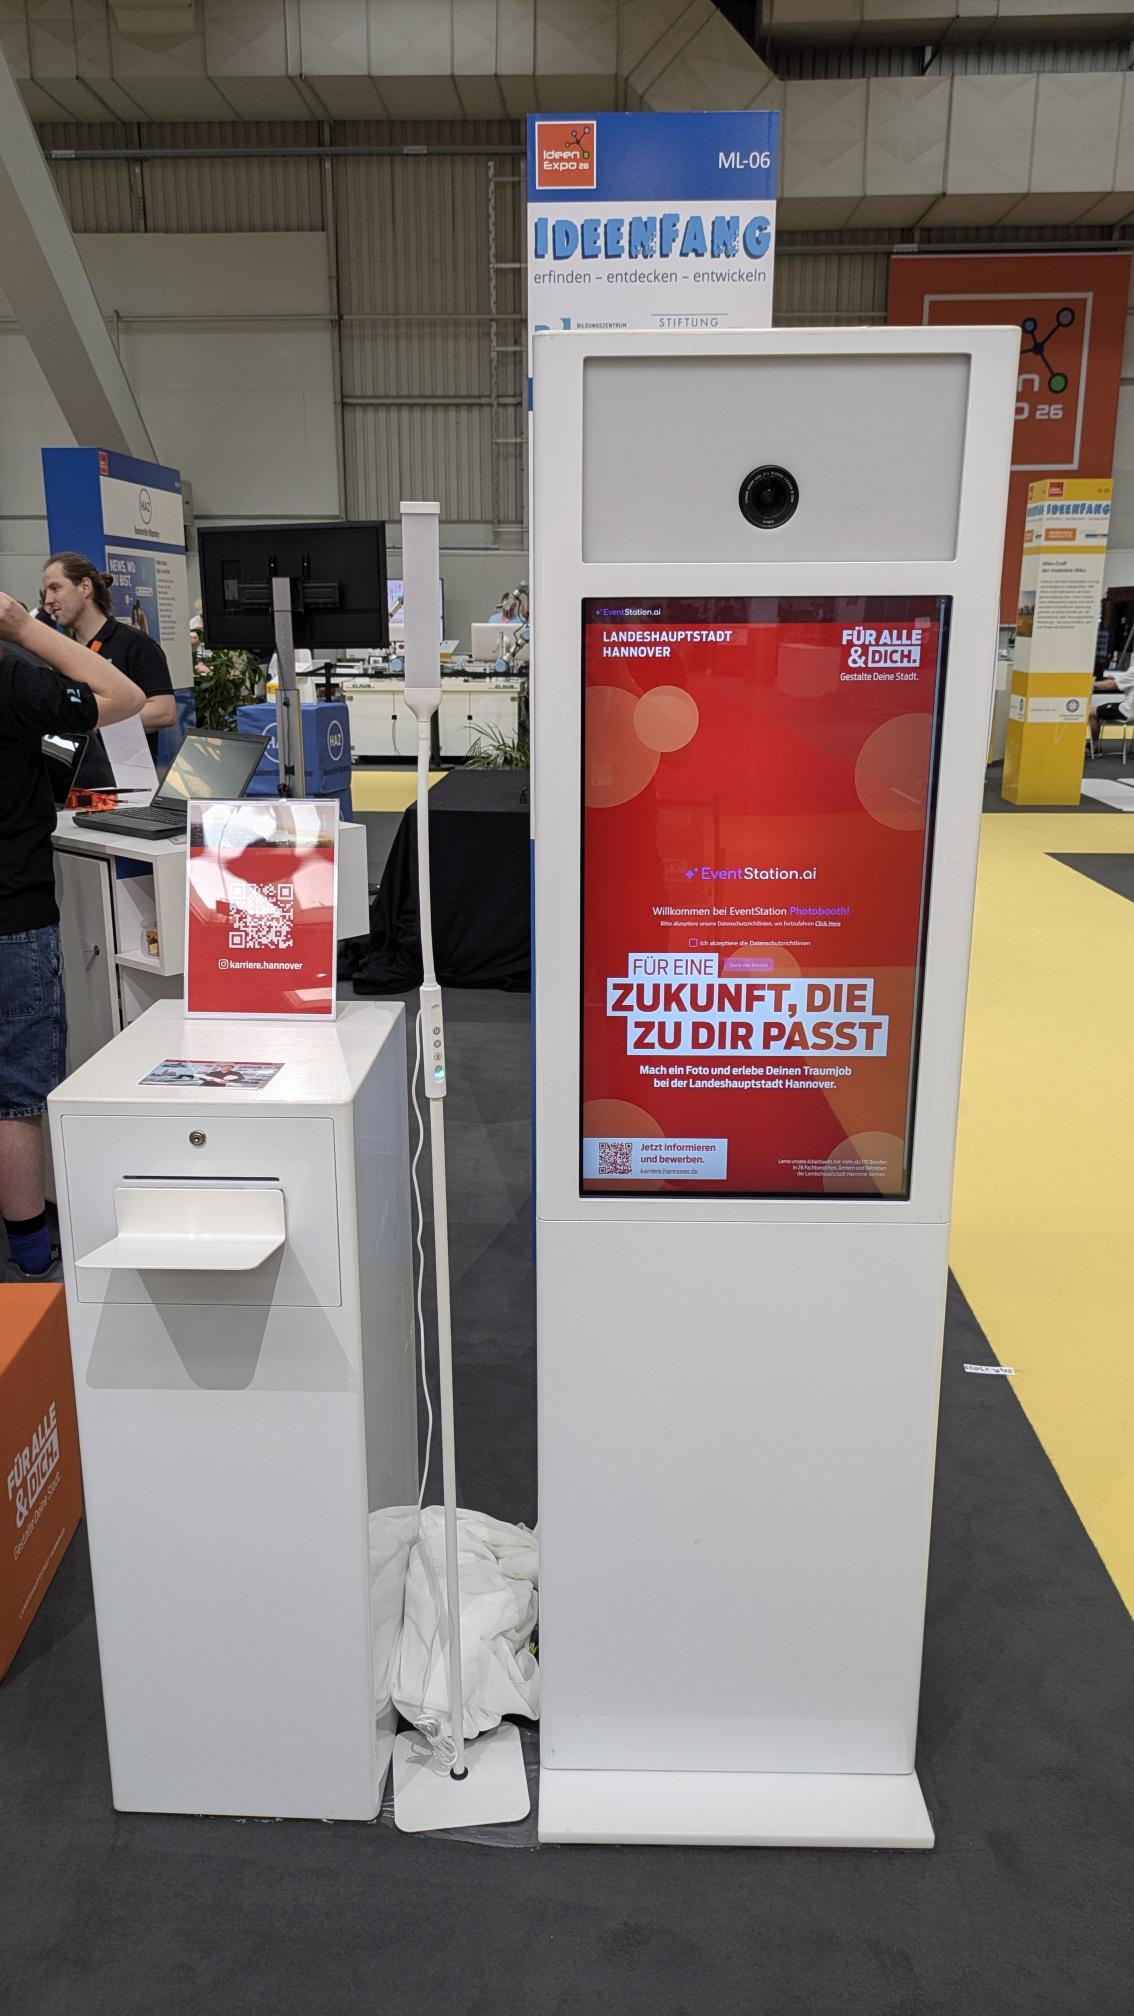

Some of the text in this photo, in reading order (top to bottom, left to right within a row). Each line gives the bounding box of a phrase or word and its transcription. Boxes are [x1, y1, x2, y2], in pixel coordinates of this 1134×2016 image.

[543, 150, 580, 160] Ideen
[718, 151, 771, 169] ML-06
[543, 160, 577, 172] Expo
[534, 213, 772, 261] IDEENFANG
[533, 270, 592, 284] erfinden
[606, 269, 678, 284] entdecken
[693, 269, 766, 283] entwickeln
[659, 317, 719, 328] STIFTUNG
[1035, 403, 1064, 420] 26
[603, 608, 661, 617] EventStation.ai
[603, 631, 732, 643] LANDESHAUPTSTADT
[842, 626, 922, 645] FÜR ALLE
[603, 646, 671, 658] HANNOVER
[847, 647, 917, 667] & DICH.
[840, 672, 919, 681] Gestalte Deine Stadt.
[329, 735, 342, 747] HAZ
[701, 866, 816, 880] EventStation.ai
[652, 906, 850, 916] Willkommen bei EventStation Photobooth!
[672, 920, 699, 928] akzeptiere
[815, 920, 828, 928] Click
[828, 920, 842, 928] Here
[709, 940, 738, 948] akzeptiere
[229, 959, 304, 971] karriere.hannover
[632, 955, 714, 976] FÜR EINE
[611, 983, 868, 1018] ZUKUNFT, DIE
[632, 1021, 883, 1051] ZU DIR PASST
[639, 1065, 852, 1078] Mach ein Foto und erlebe Deinen Traumjob
[653, 1078, 837, 1091] bei der Landeshauptstadt Hannover.
[640, 1143, 663, 1152] Jetzt
[640, 1155, 706, 1164] und bewerben.
[7, 1400, 58, 1501] FÜR ALLE
[16, 1487, 29, 1529] &
